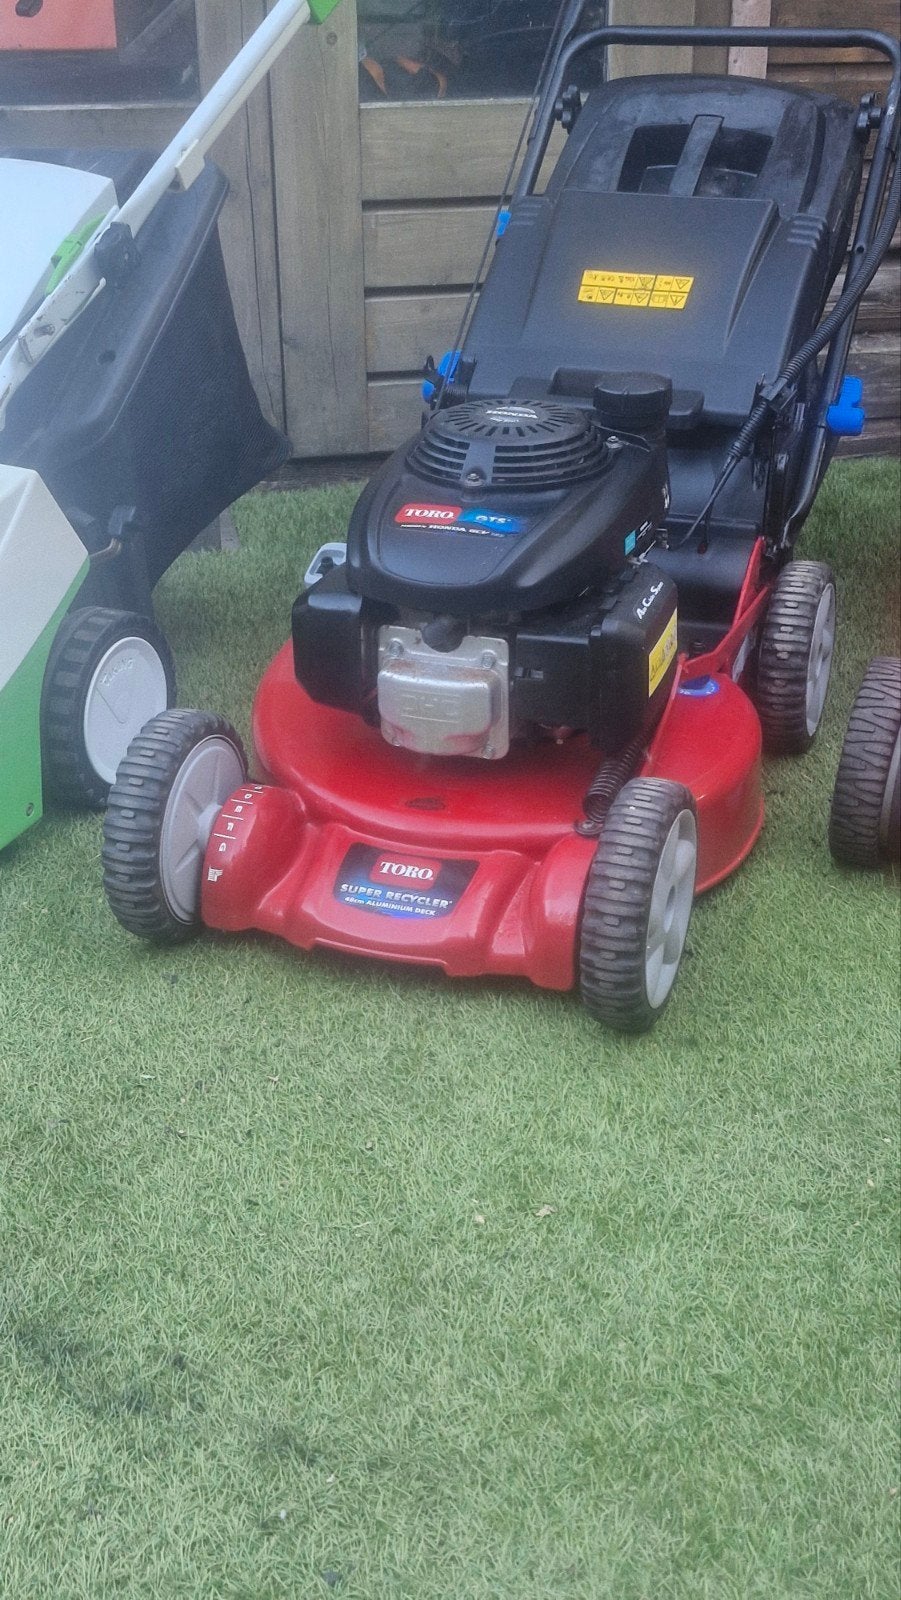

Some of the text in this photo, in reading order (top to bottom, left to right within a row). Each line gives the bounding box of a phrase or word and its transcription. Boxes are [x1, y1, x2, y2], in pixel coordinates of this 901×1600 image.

[405, 508, 454, 519] TORO
[429, 524, 467, 532] HONDA
[380, 861, 433, 880] TORO
[340, 884, 449, 908] SUPER RECYCLER
[344, 896, 436, 916] 48cm ALUMINIUM DECK
